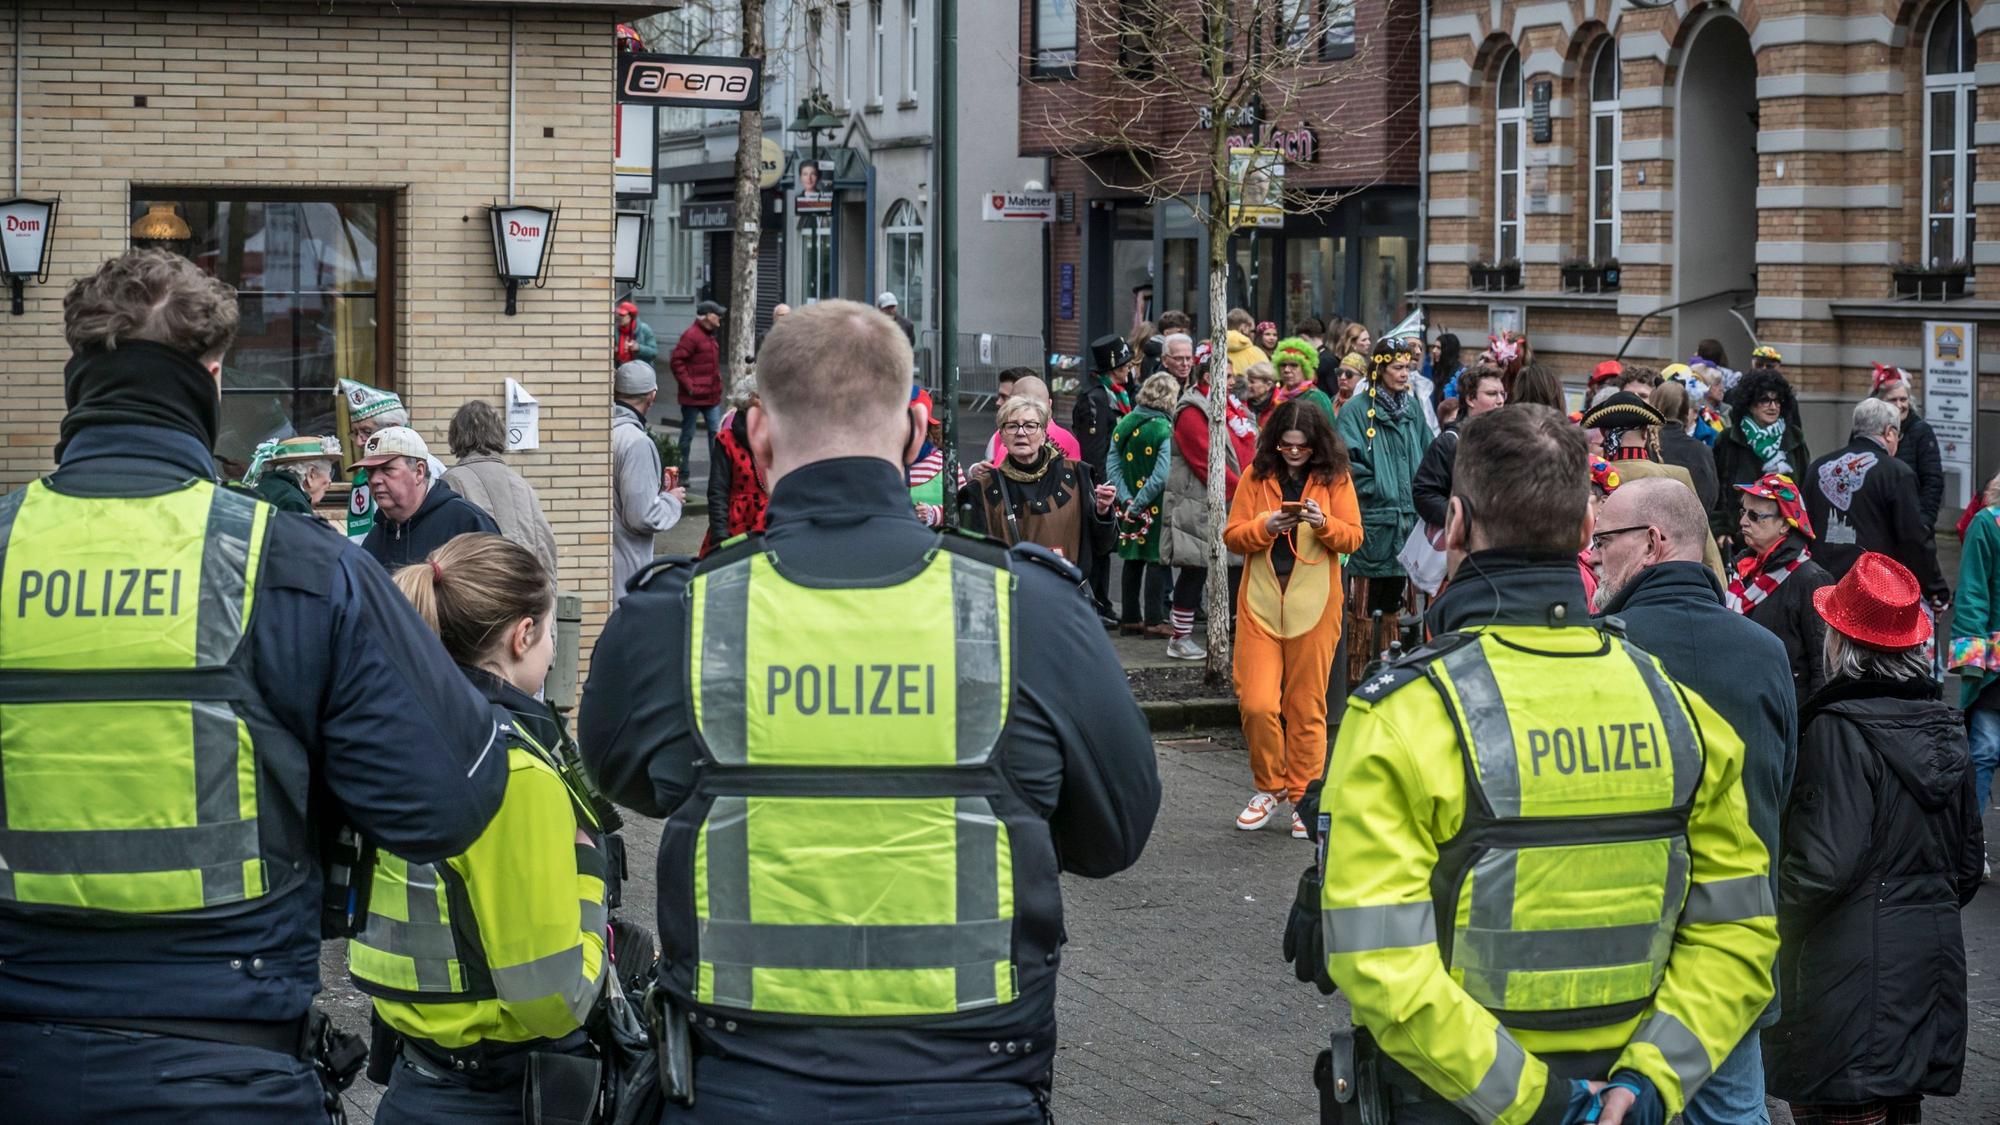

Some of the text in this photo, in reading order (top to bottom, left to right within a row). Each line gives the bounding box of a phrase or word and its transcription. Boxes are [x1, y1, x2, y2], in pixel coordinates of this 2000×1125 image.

[638, 70, 747, 93] arena
[1008, 195, 1051, 207] Malteser
[6, 215, 40, 231] Dom
[509, 220, 540, 237] Dom
[18, 569, 182, 618] POLIZEI
[767, 664, 935, 716] POLIZEI
[1527, 722, 1662, 777] POLIZEI
